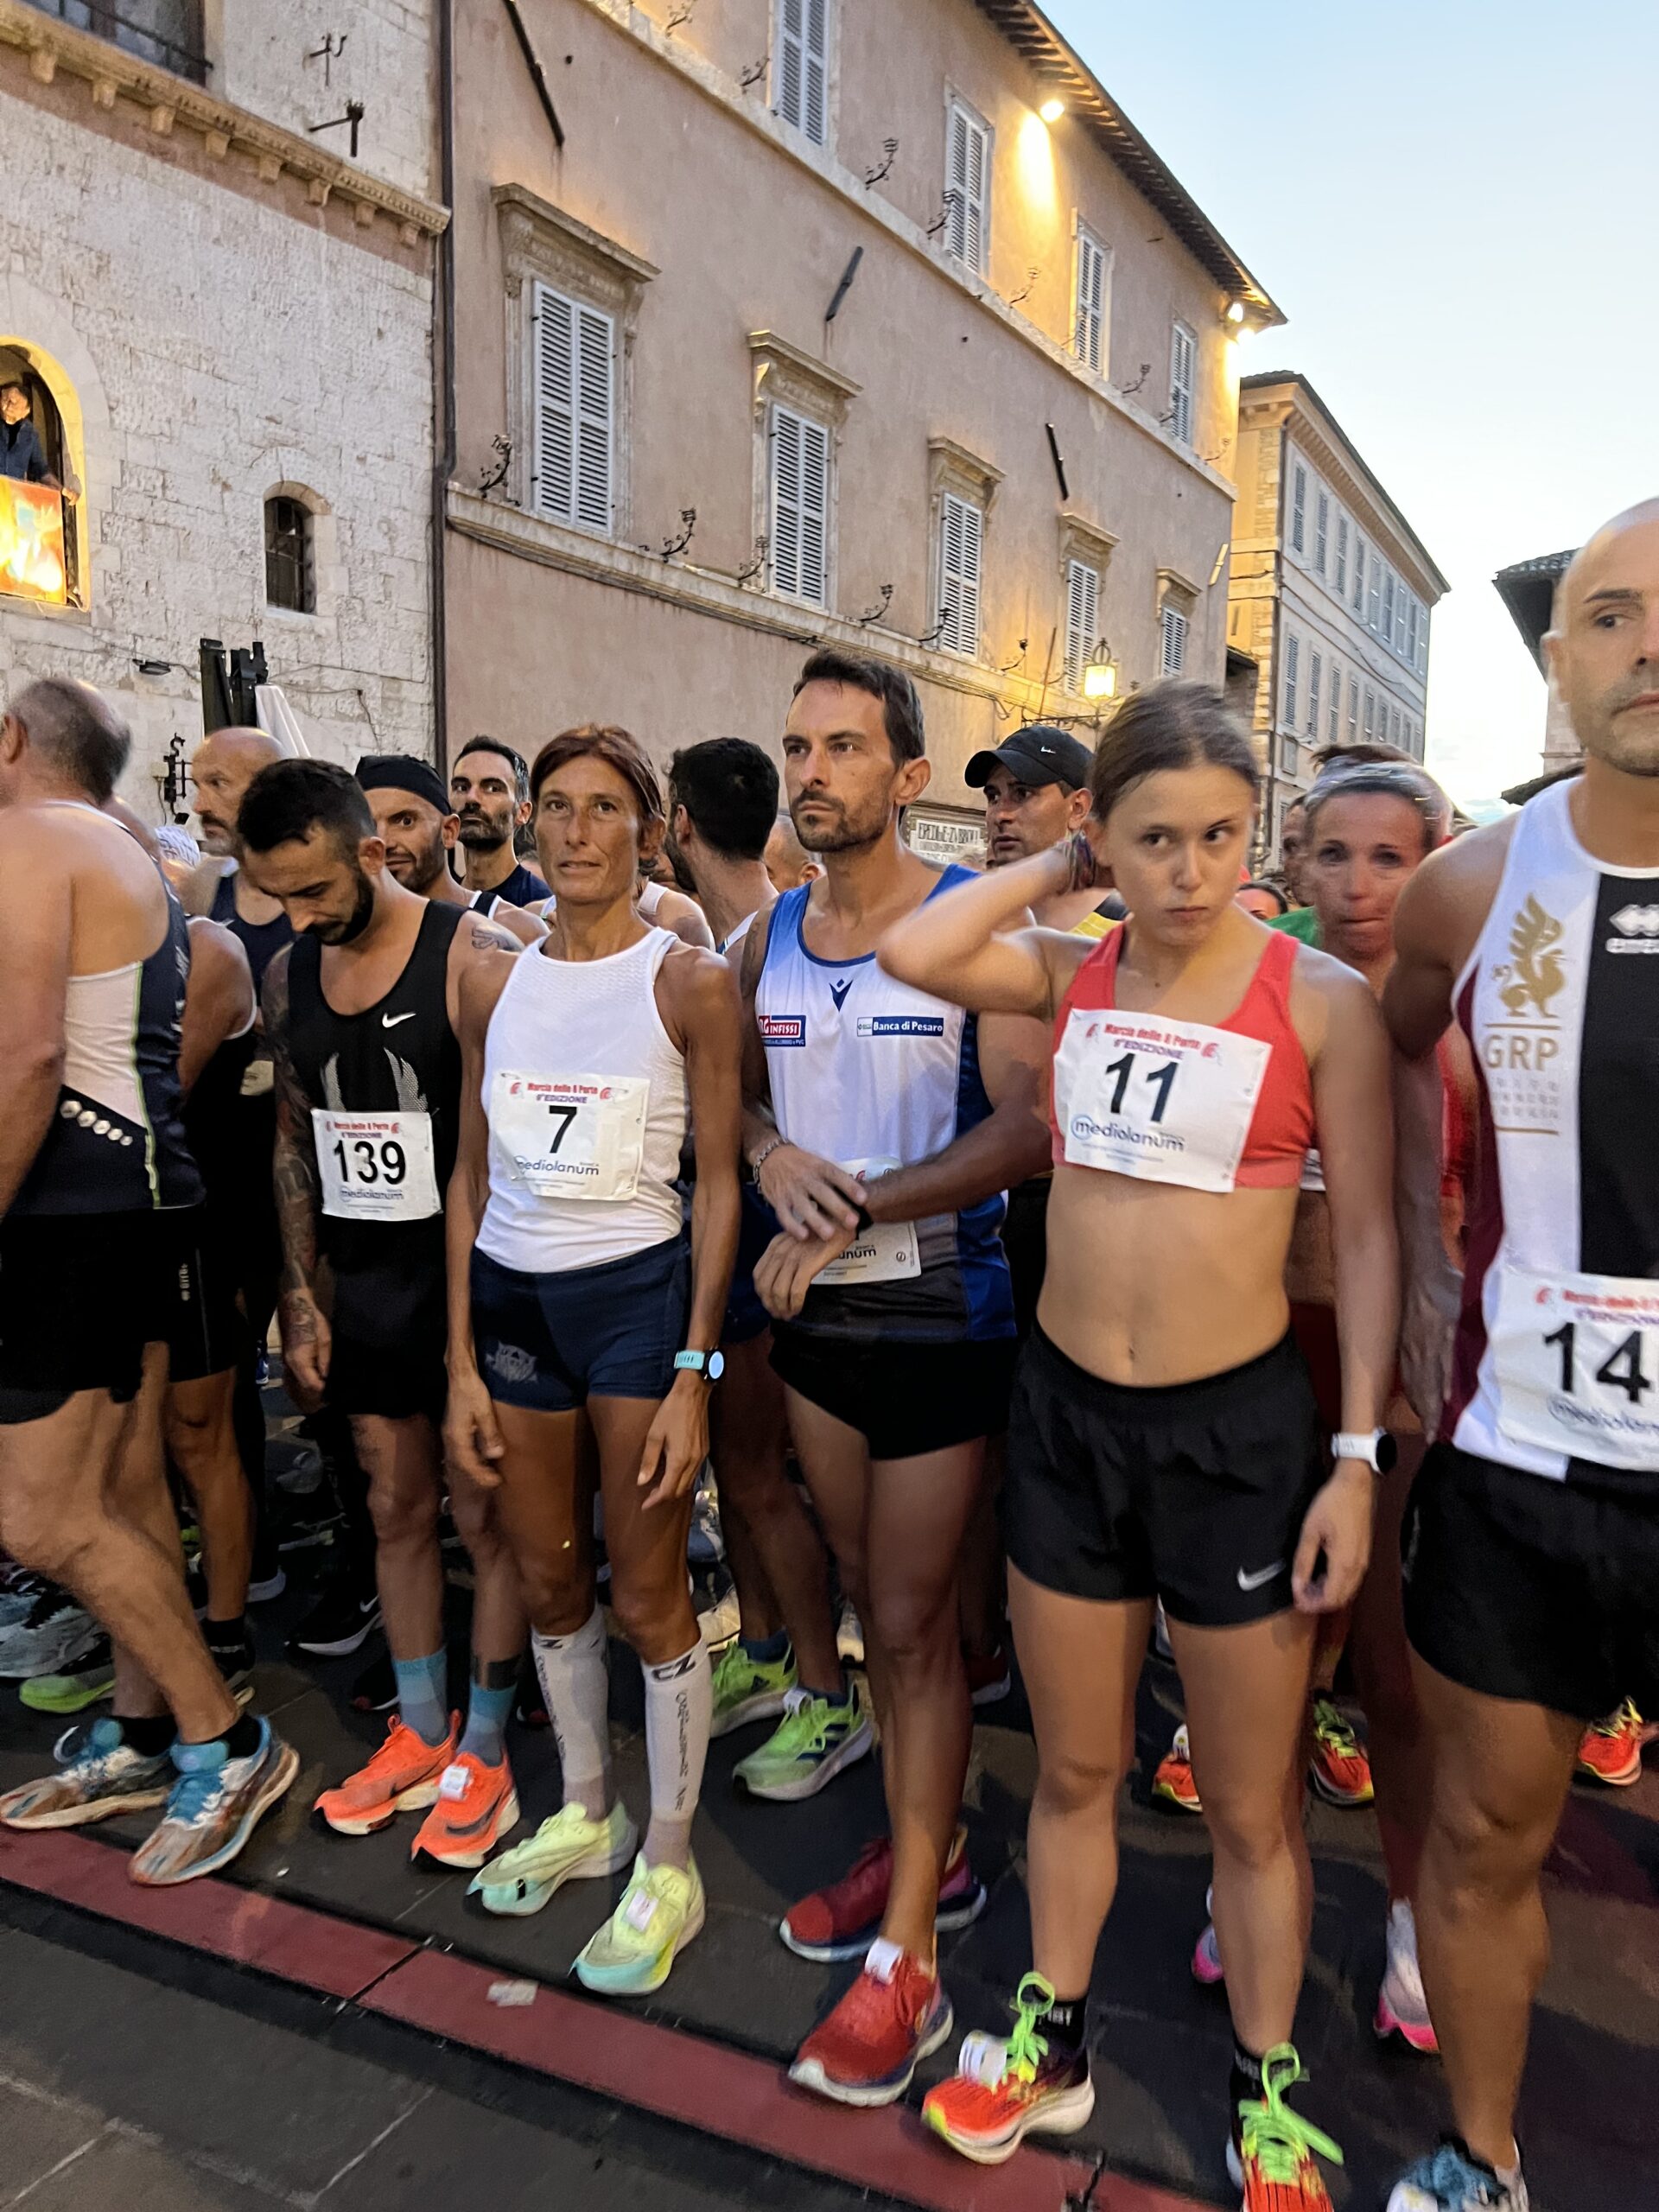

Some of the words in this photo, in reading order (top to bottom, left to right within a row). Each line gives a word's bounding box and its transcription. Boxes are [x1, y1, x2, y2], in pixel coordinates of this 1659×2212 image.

[770, 1024, 798, 1034] INFISSI
[873, 1020, 899, 1031] Banca
[901, 1020, 910, 1030] di
[912, 1021, 943, 1033] Pesaro
[1484, 1035, 1559, 1071] GRP
[1106, 1053, 1179, 1122] 11
[549, 1105, 577, 1153] 7
[1075, 1120, 1184, 1151] mediolanum
[334, 1140, 406, 1185] 139
[340, 1187, 404, 1200] mediolanum
